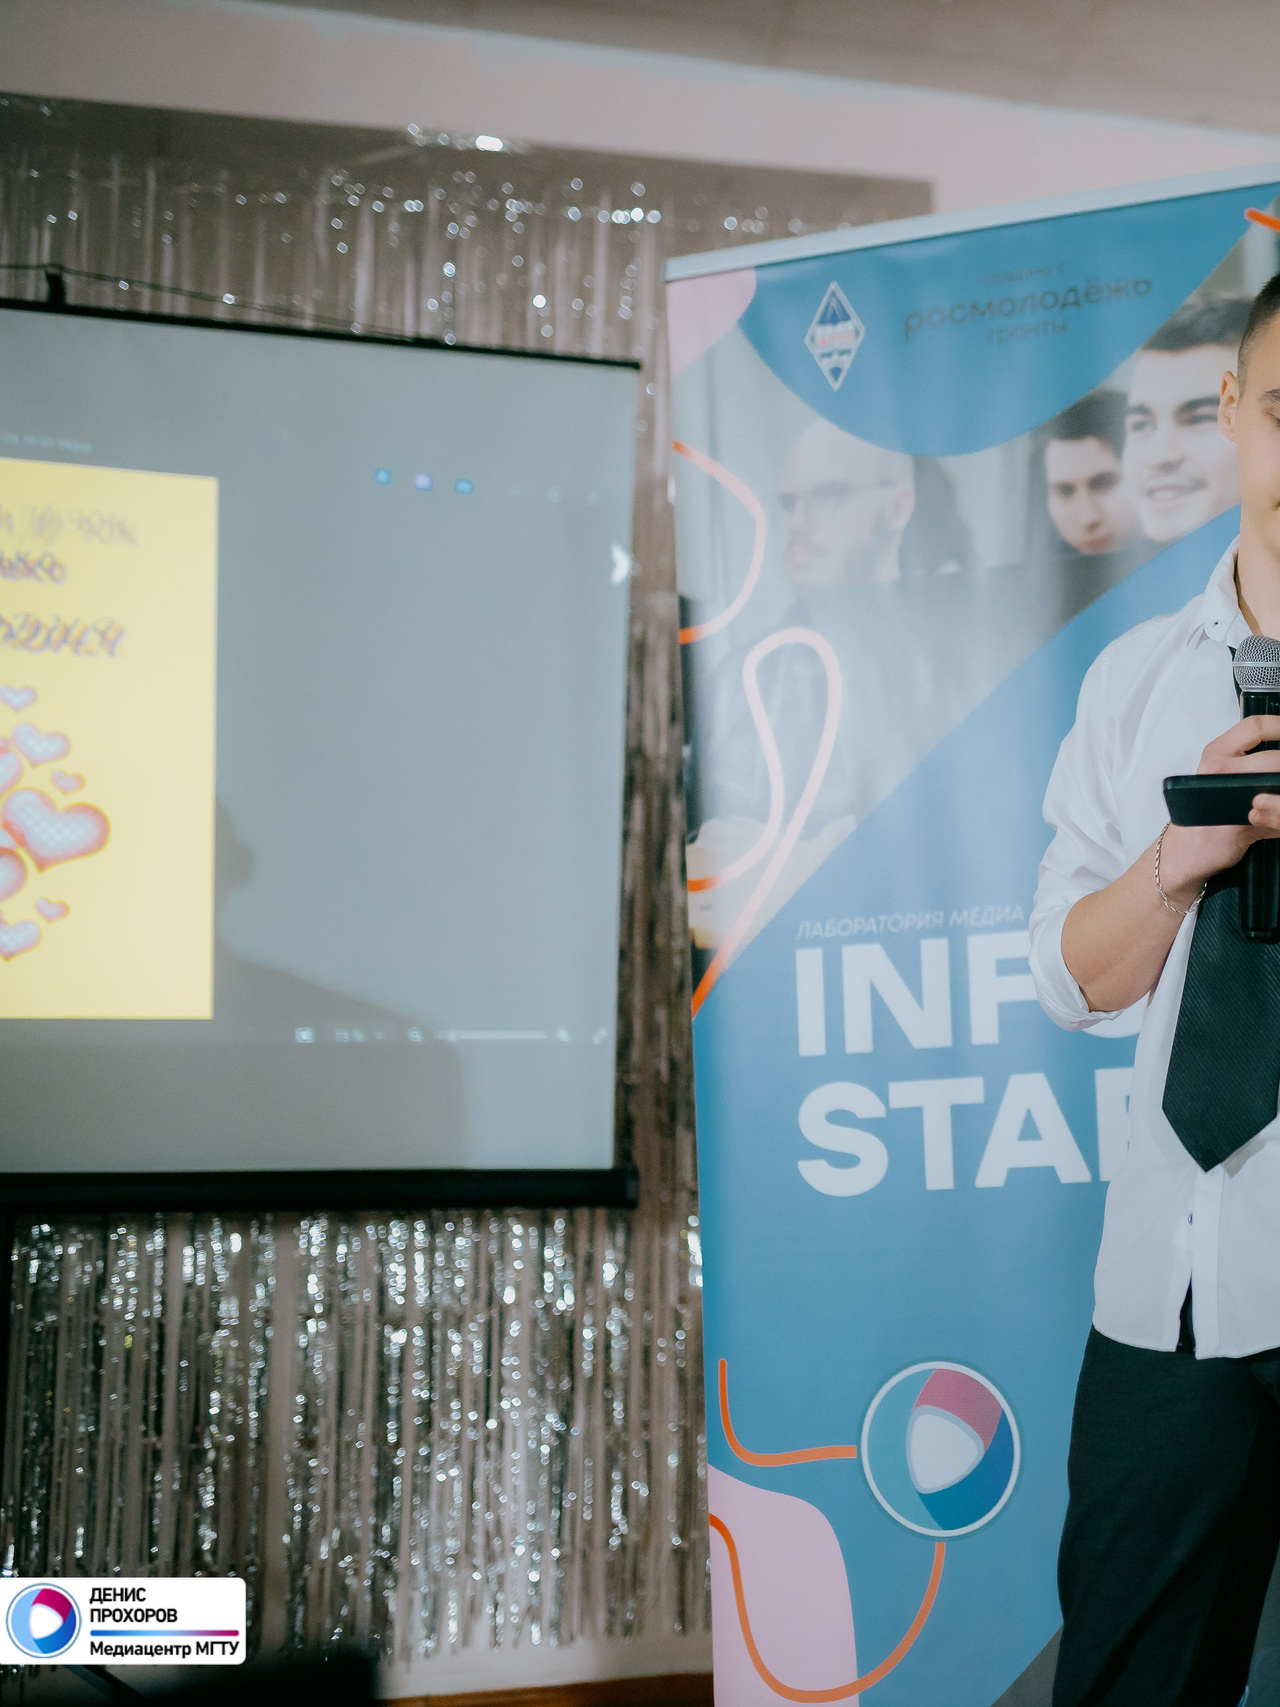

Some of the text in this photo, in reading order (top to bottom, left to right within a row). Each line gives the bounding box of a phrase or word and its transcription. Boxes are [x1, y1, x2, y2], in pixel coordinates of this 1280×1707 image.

[904, 276, 1152, 343] росмолодёжь
[795, 905, 1025, 940] ЛАБОРАТОРИЯ МЕДИА
[795, 930, 1145, 1057] INF
